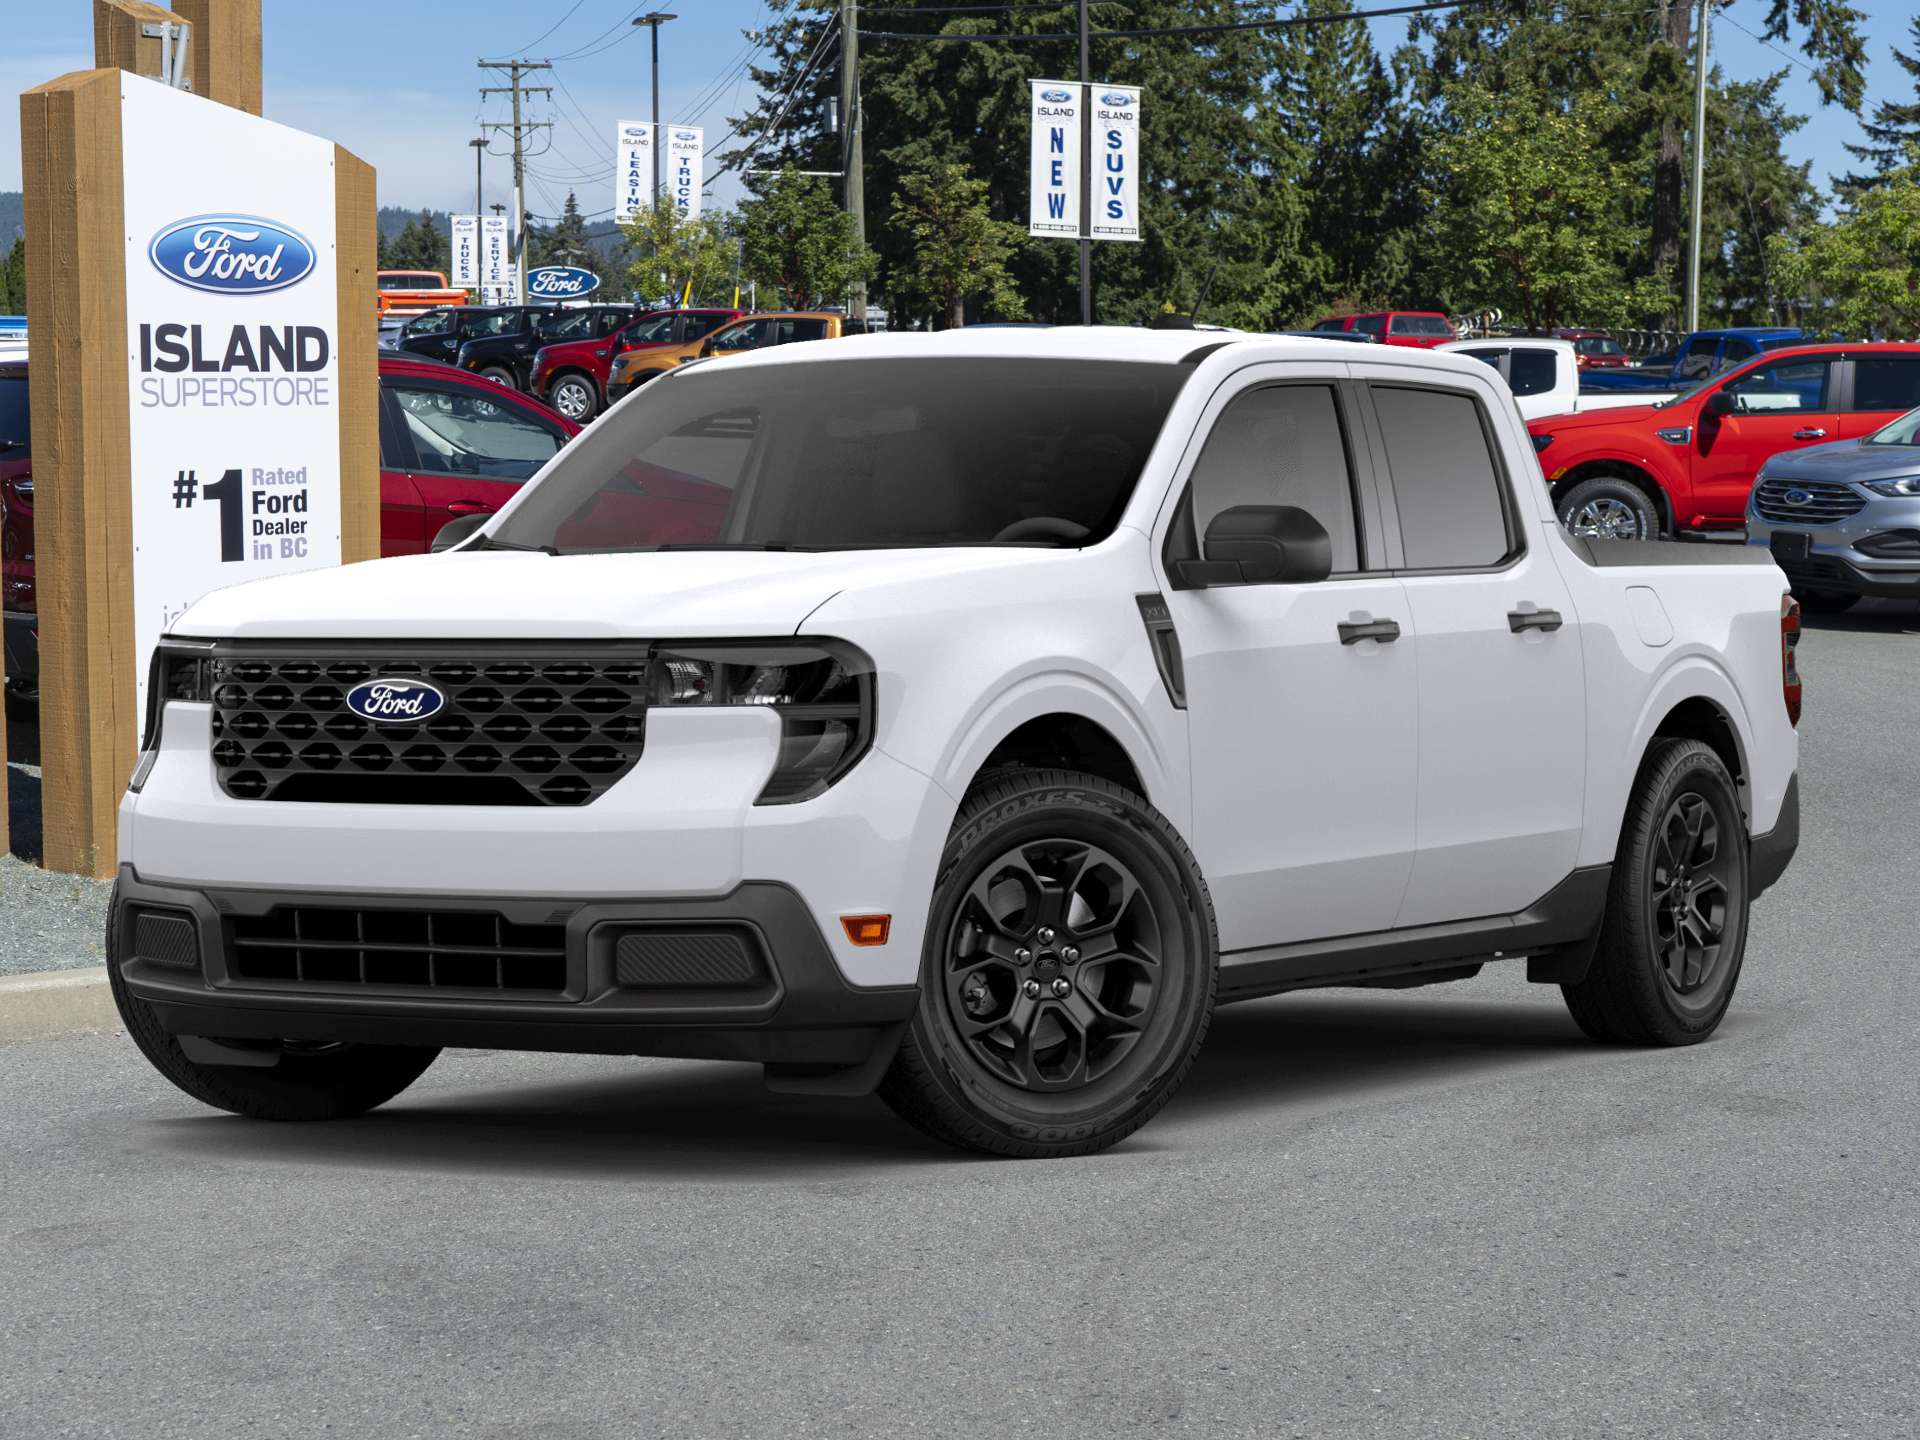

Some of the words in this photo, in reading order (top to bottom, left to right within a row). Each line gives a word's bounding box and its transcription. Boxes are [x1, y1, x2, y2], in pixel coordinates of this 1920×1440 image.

[1037, 107, 1074, 117] ISLAND
[1098, 111, 1133, 120] ISLAND
[678, 157, 690, 218] TRUCKS
[1048, 127, 1066, 219] NEW
[1106, 130, 1124, 219] SUVS
[184, 226, 284, 281] Ford
[461, 237, 470, 279] TRUCKS
[490, 236, 500, 281] SERVICE
[532, 271, 583, 292] Ford
[140, 323, 329, 373] ISLAND
[141, 377, 329, 407] SUPERSTORE
[252, 466, 307, 486] Rated
[172, 469, 244, 562] #1
[252, 489, 308, 514] Ford
[253, 518, 307, 536] Dealer
[253, 540, 273, 560] in
[280, 537, 308, 558] BC
[364, 684, 425, 714] Ford
